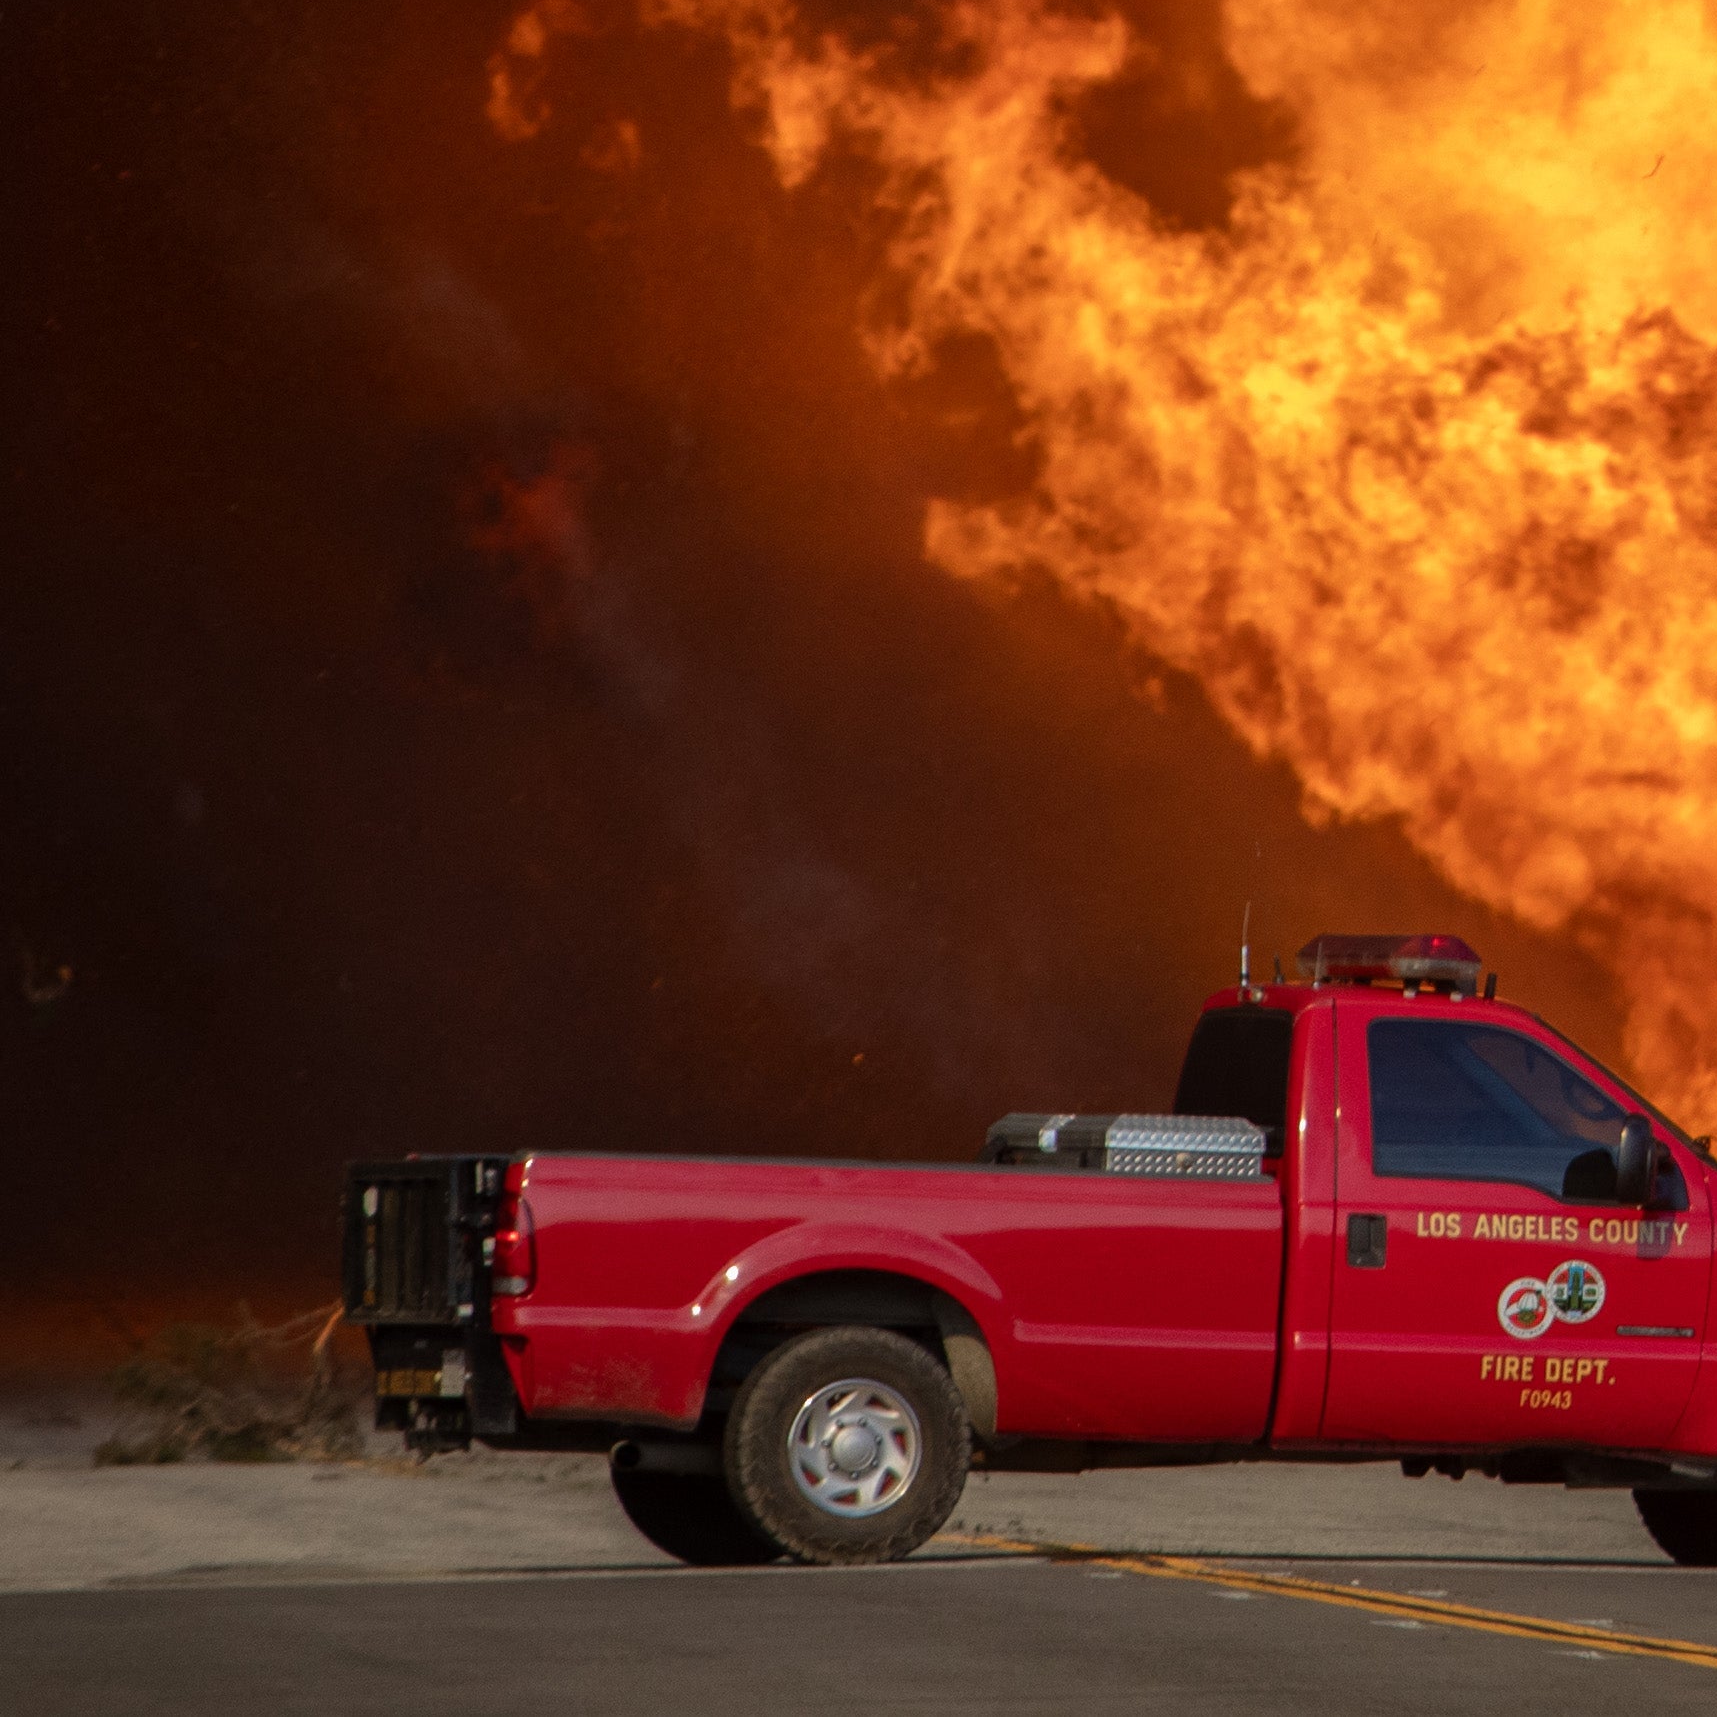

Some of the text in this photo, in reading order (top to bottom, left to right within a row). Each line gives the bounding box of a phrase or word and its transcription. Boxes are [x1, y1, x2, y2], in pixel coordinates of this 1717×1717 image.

[1416, 1212, 1688, 1246] LOS ANGELES COUNTY
[1481, 1355, 1616, 1385] FIRE DEPT.
[1520, 1389, 1573, 1409] F0943
